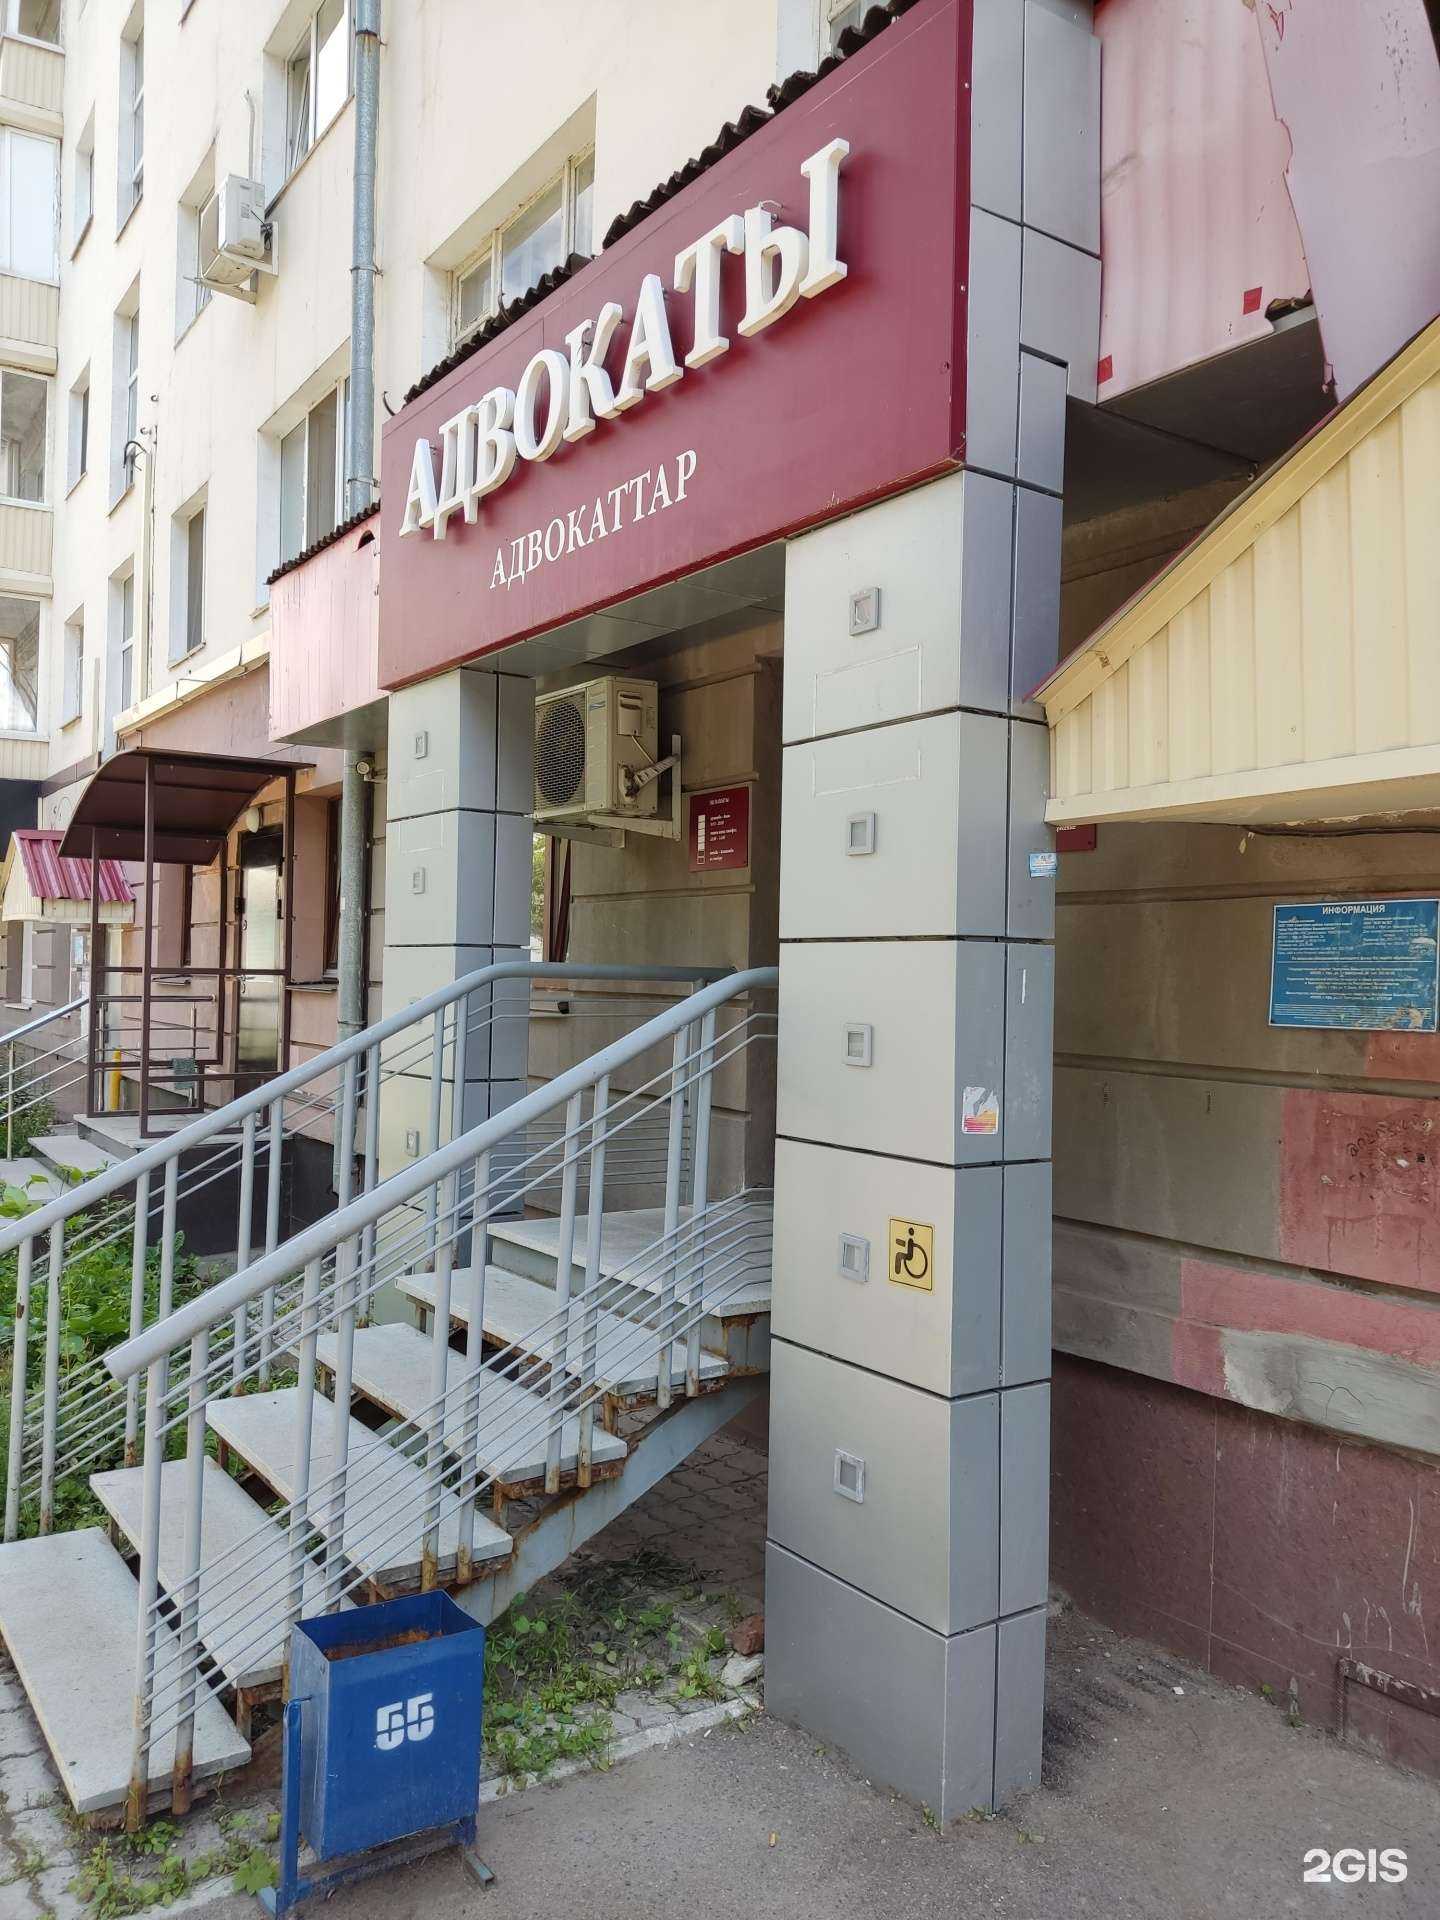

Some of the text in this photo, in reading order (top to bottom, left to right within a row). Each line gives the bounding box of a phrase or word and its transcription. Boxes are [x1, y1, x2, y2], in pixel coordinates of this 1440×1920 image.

[399, 137, 850, 540] АДВОКАТЫ
[489, 449, 698, 591] АДВОКАТТАР
[1322, 904, 1385, 914] ИНФОРМАЦИЯ
